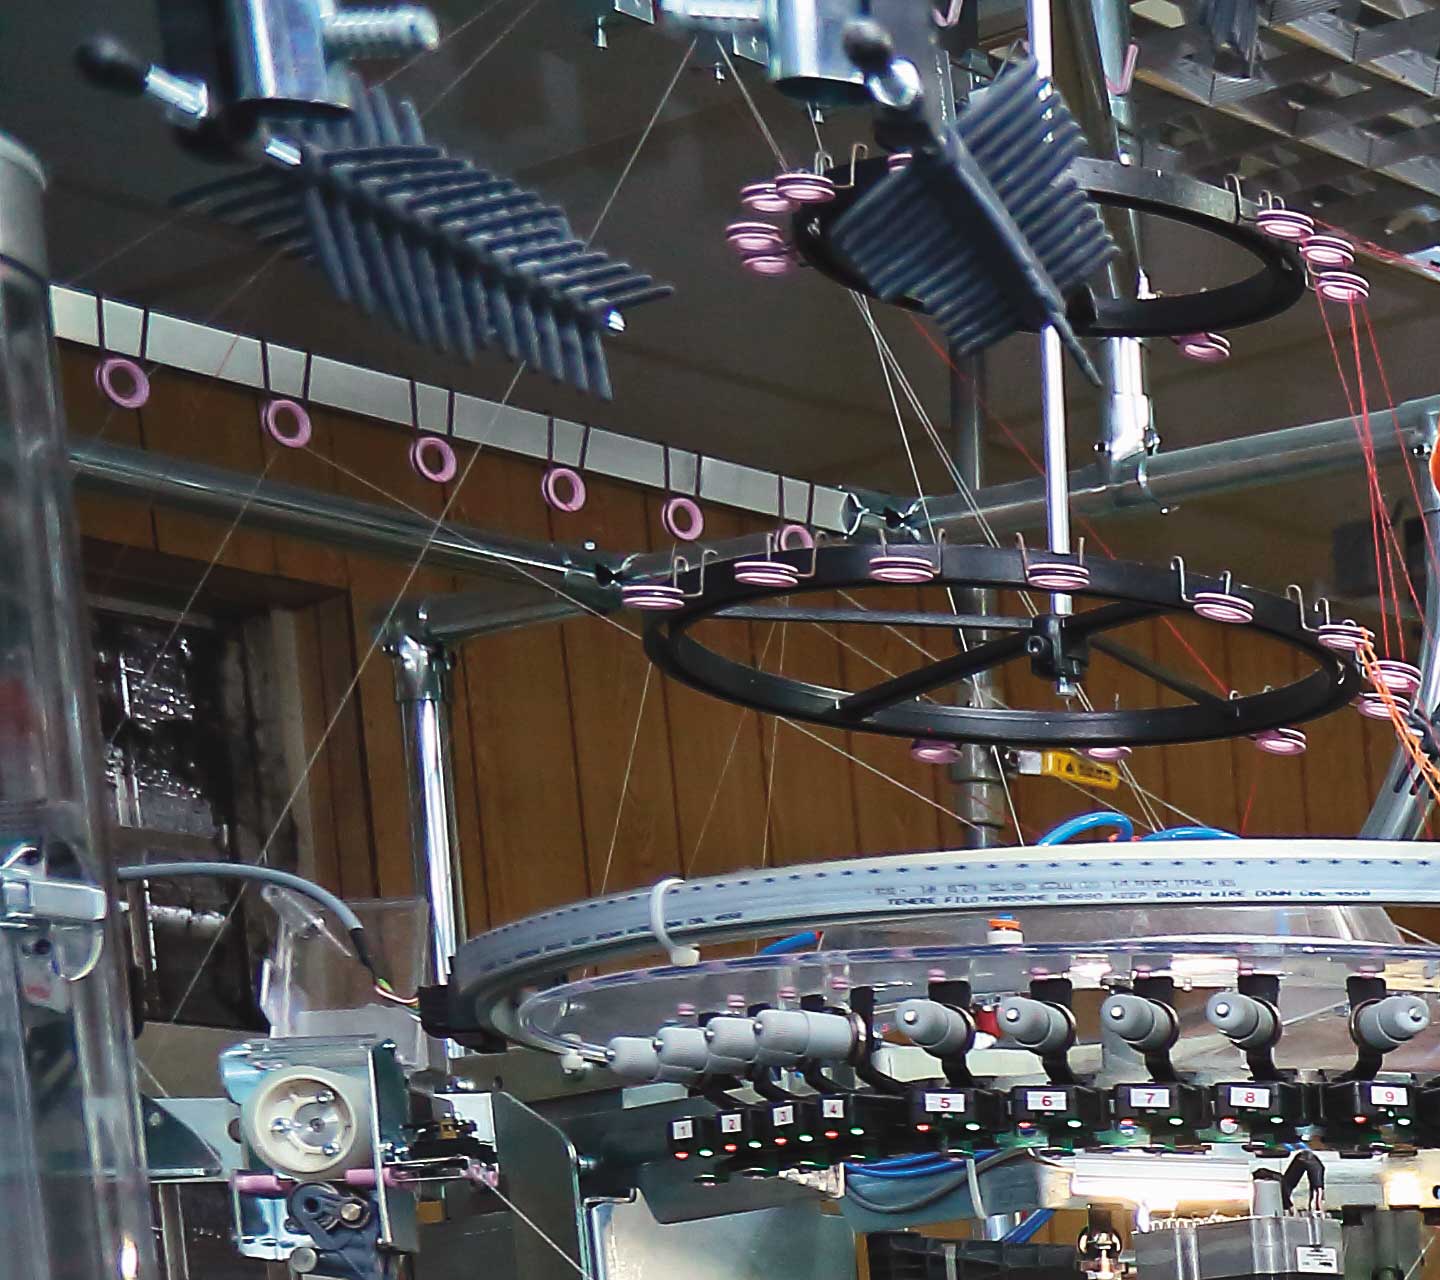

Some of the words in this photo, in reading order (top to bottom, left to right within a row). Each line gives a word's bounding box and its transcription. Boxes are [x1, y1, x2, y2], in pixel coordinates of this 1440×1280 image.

[939, 1096, 951, 1109] 5
[1041, 1095, 1053, 1107] 6
[1145, 1093, 1156, 1104] 7
[1244, 1091, 1256, 1103] 8
[1384, 1091, 1396, 1103] 9
